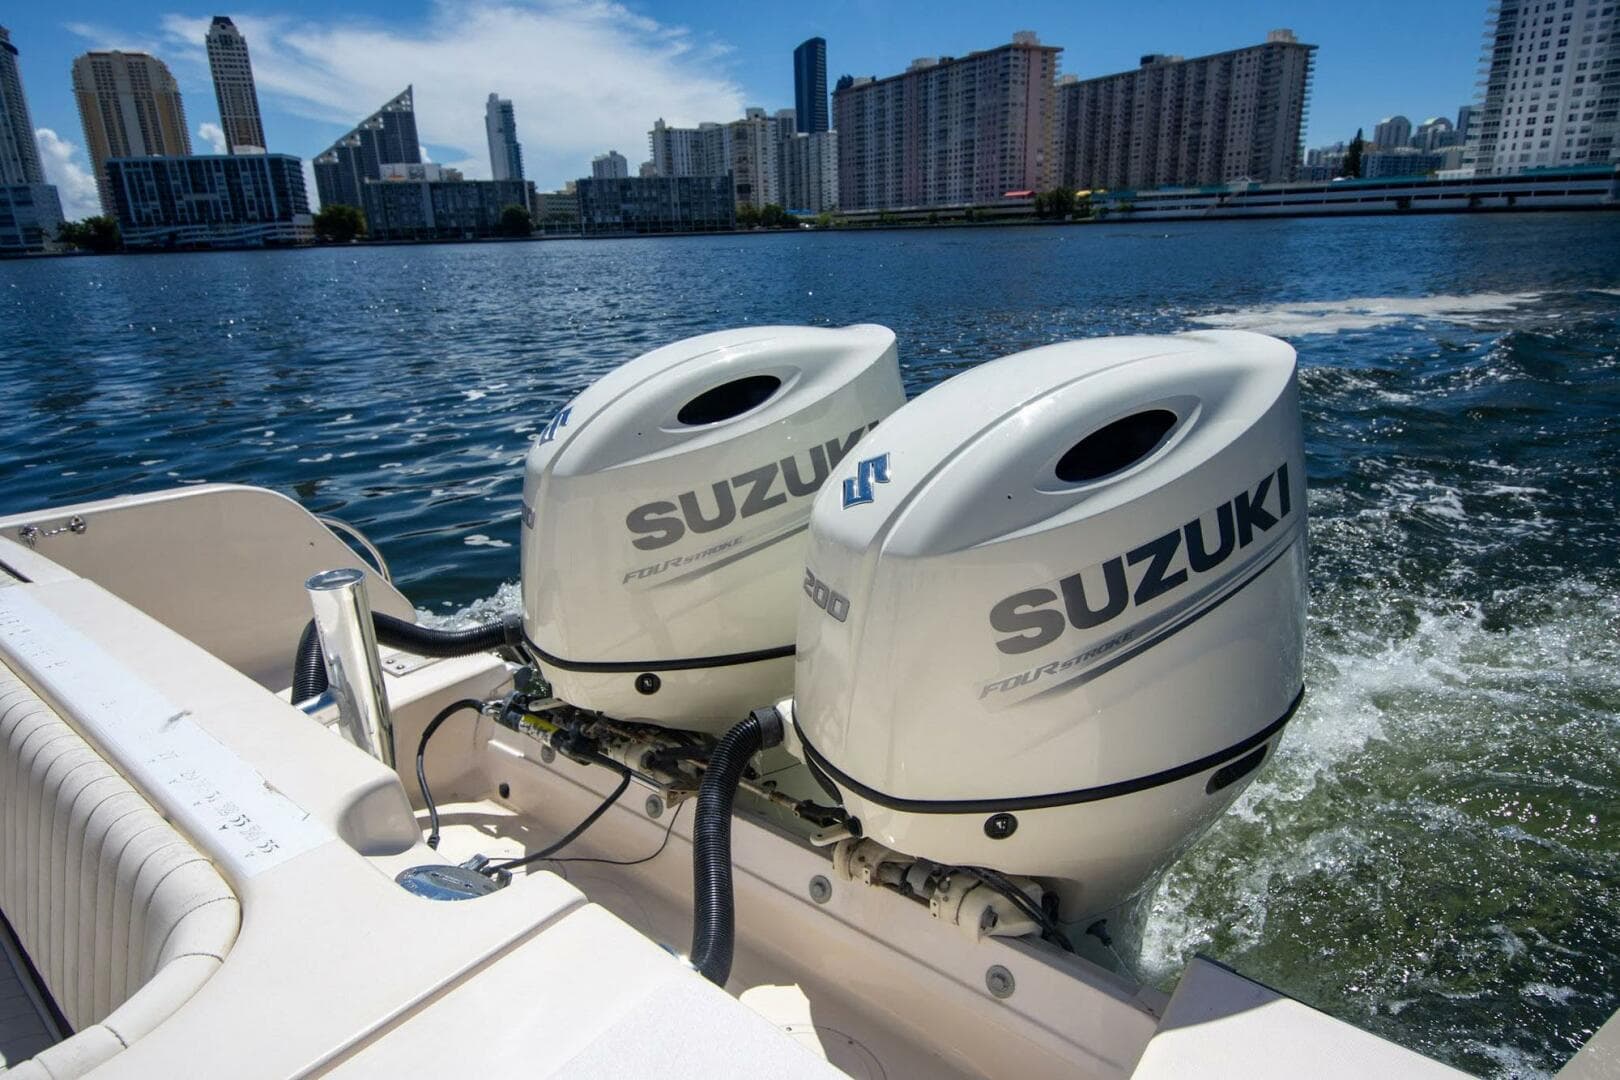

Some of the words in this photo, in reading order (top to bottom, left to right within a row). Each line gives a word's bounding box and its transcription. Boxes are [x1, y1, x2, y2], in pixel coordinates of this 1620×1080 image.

[626, 419, 879, 551] SUZUK
[803, 566, 851, 623] 200
[989, 462, 1291, 655] SUZUKI
